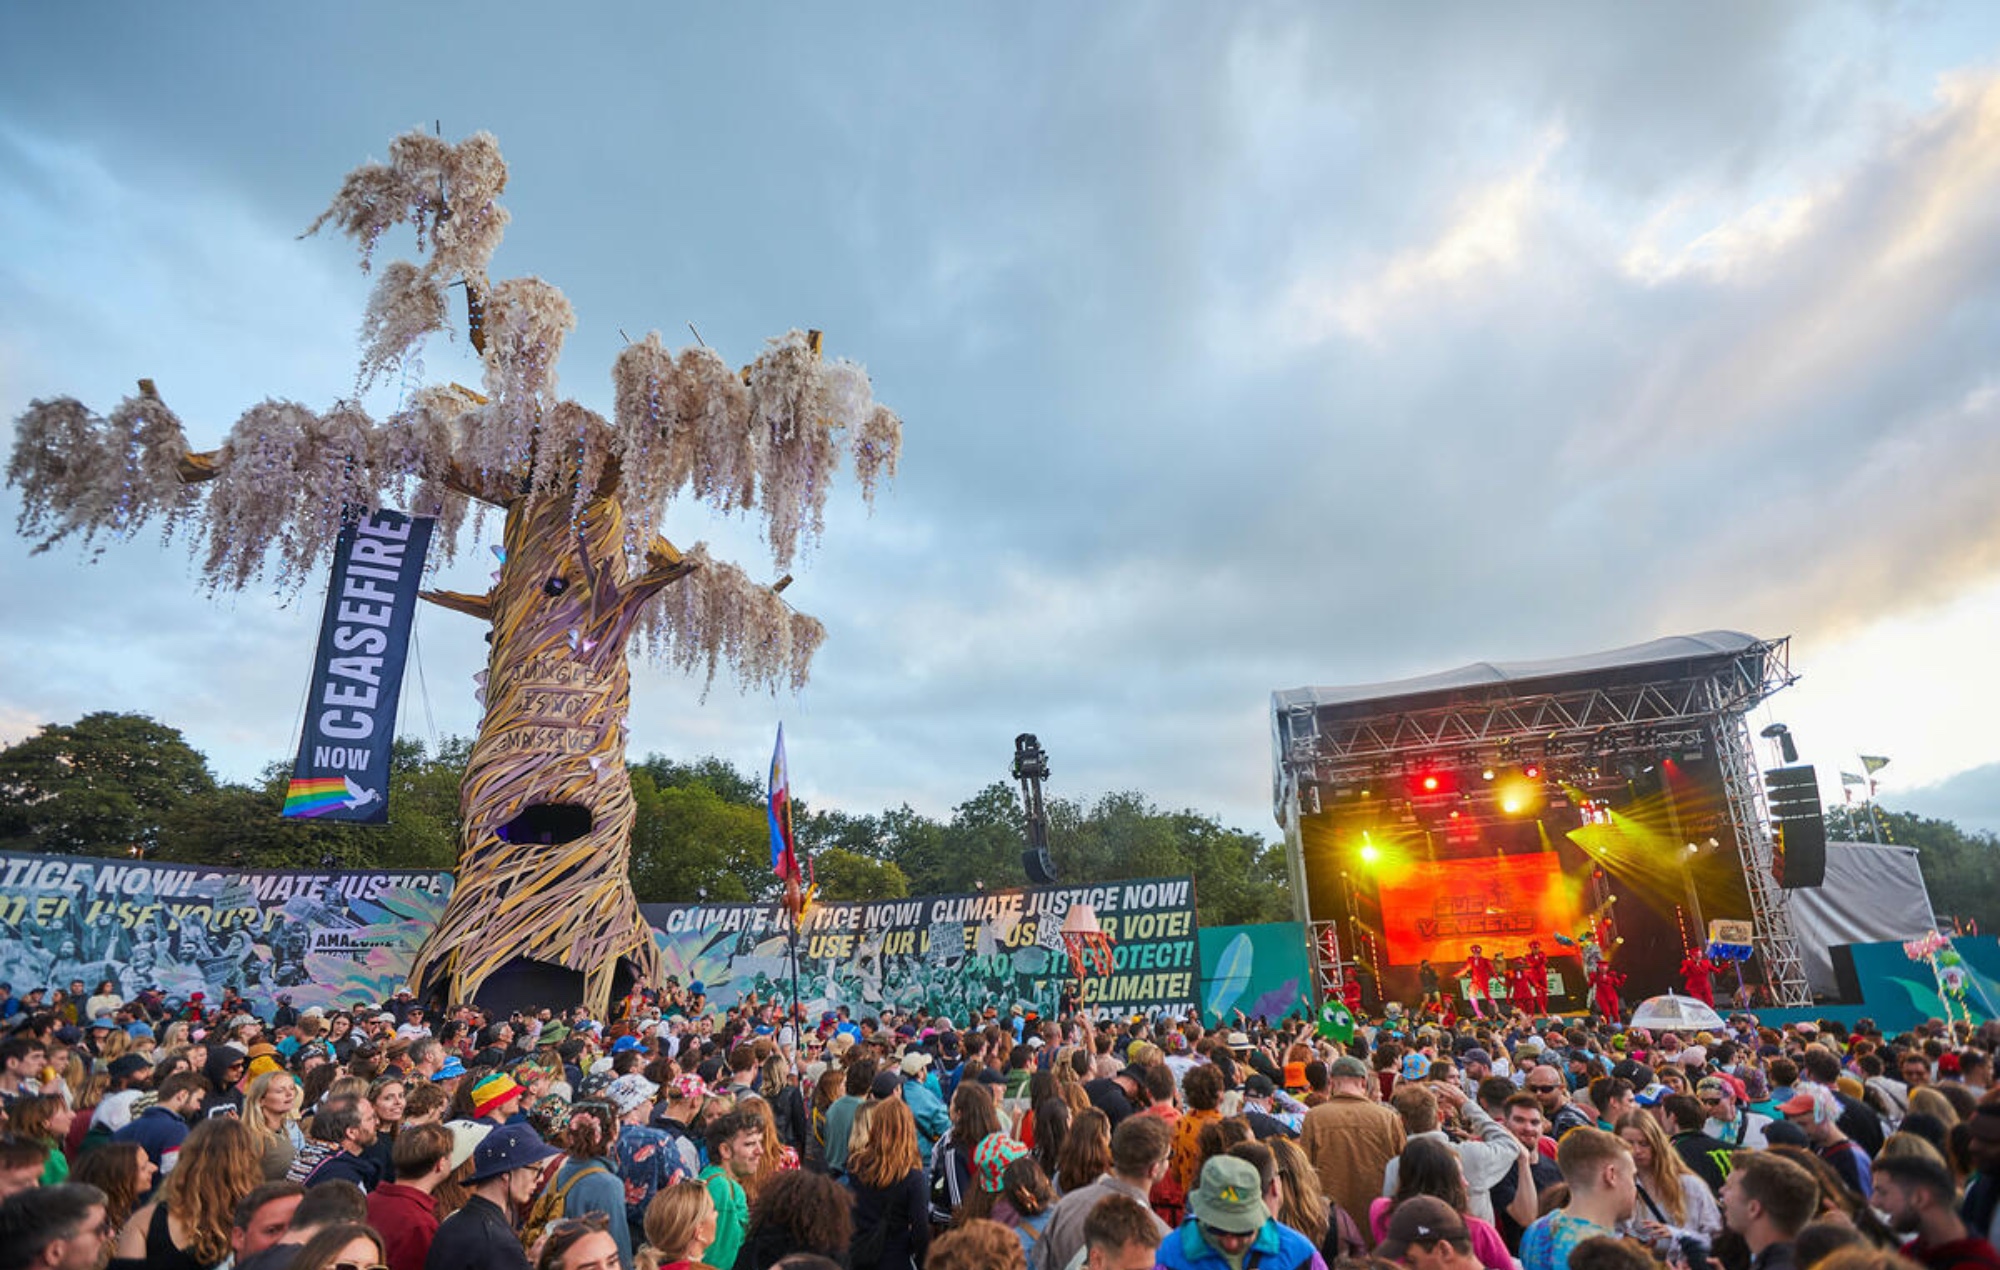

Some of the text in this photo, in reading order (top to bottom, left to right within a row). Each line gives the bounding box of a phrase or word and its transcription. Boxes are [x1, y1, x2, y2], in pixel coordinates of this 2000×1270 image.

[319, 514, 412, 740] CEASEFIRE
[314, 746, 370, 771] NOW
[0, 858, 94, 893] TICE
[95, 865, 198, 897] NOW!
[931, 881, 1189, 922] CLIMATE JUSTICE NOW!
[667, 908, 770, 932] CLIMATE
[864, 902, 922, 929] NOW!
[1123, 911, 1192, 940] VOTE!
[808, 934, 857, 959] USE
[1084, 973, 1192, 1002] CLIMATE!
